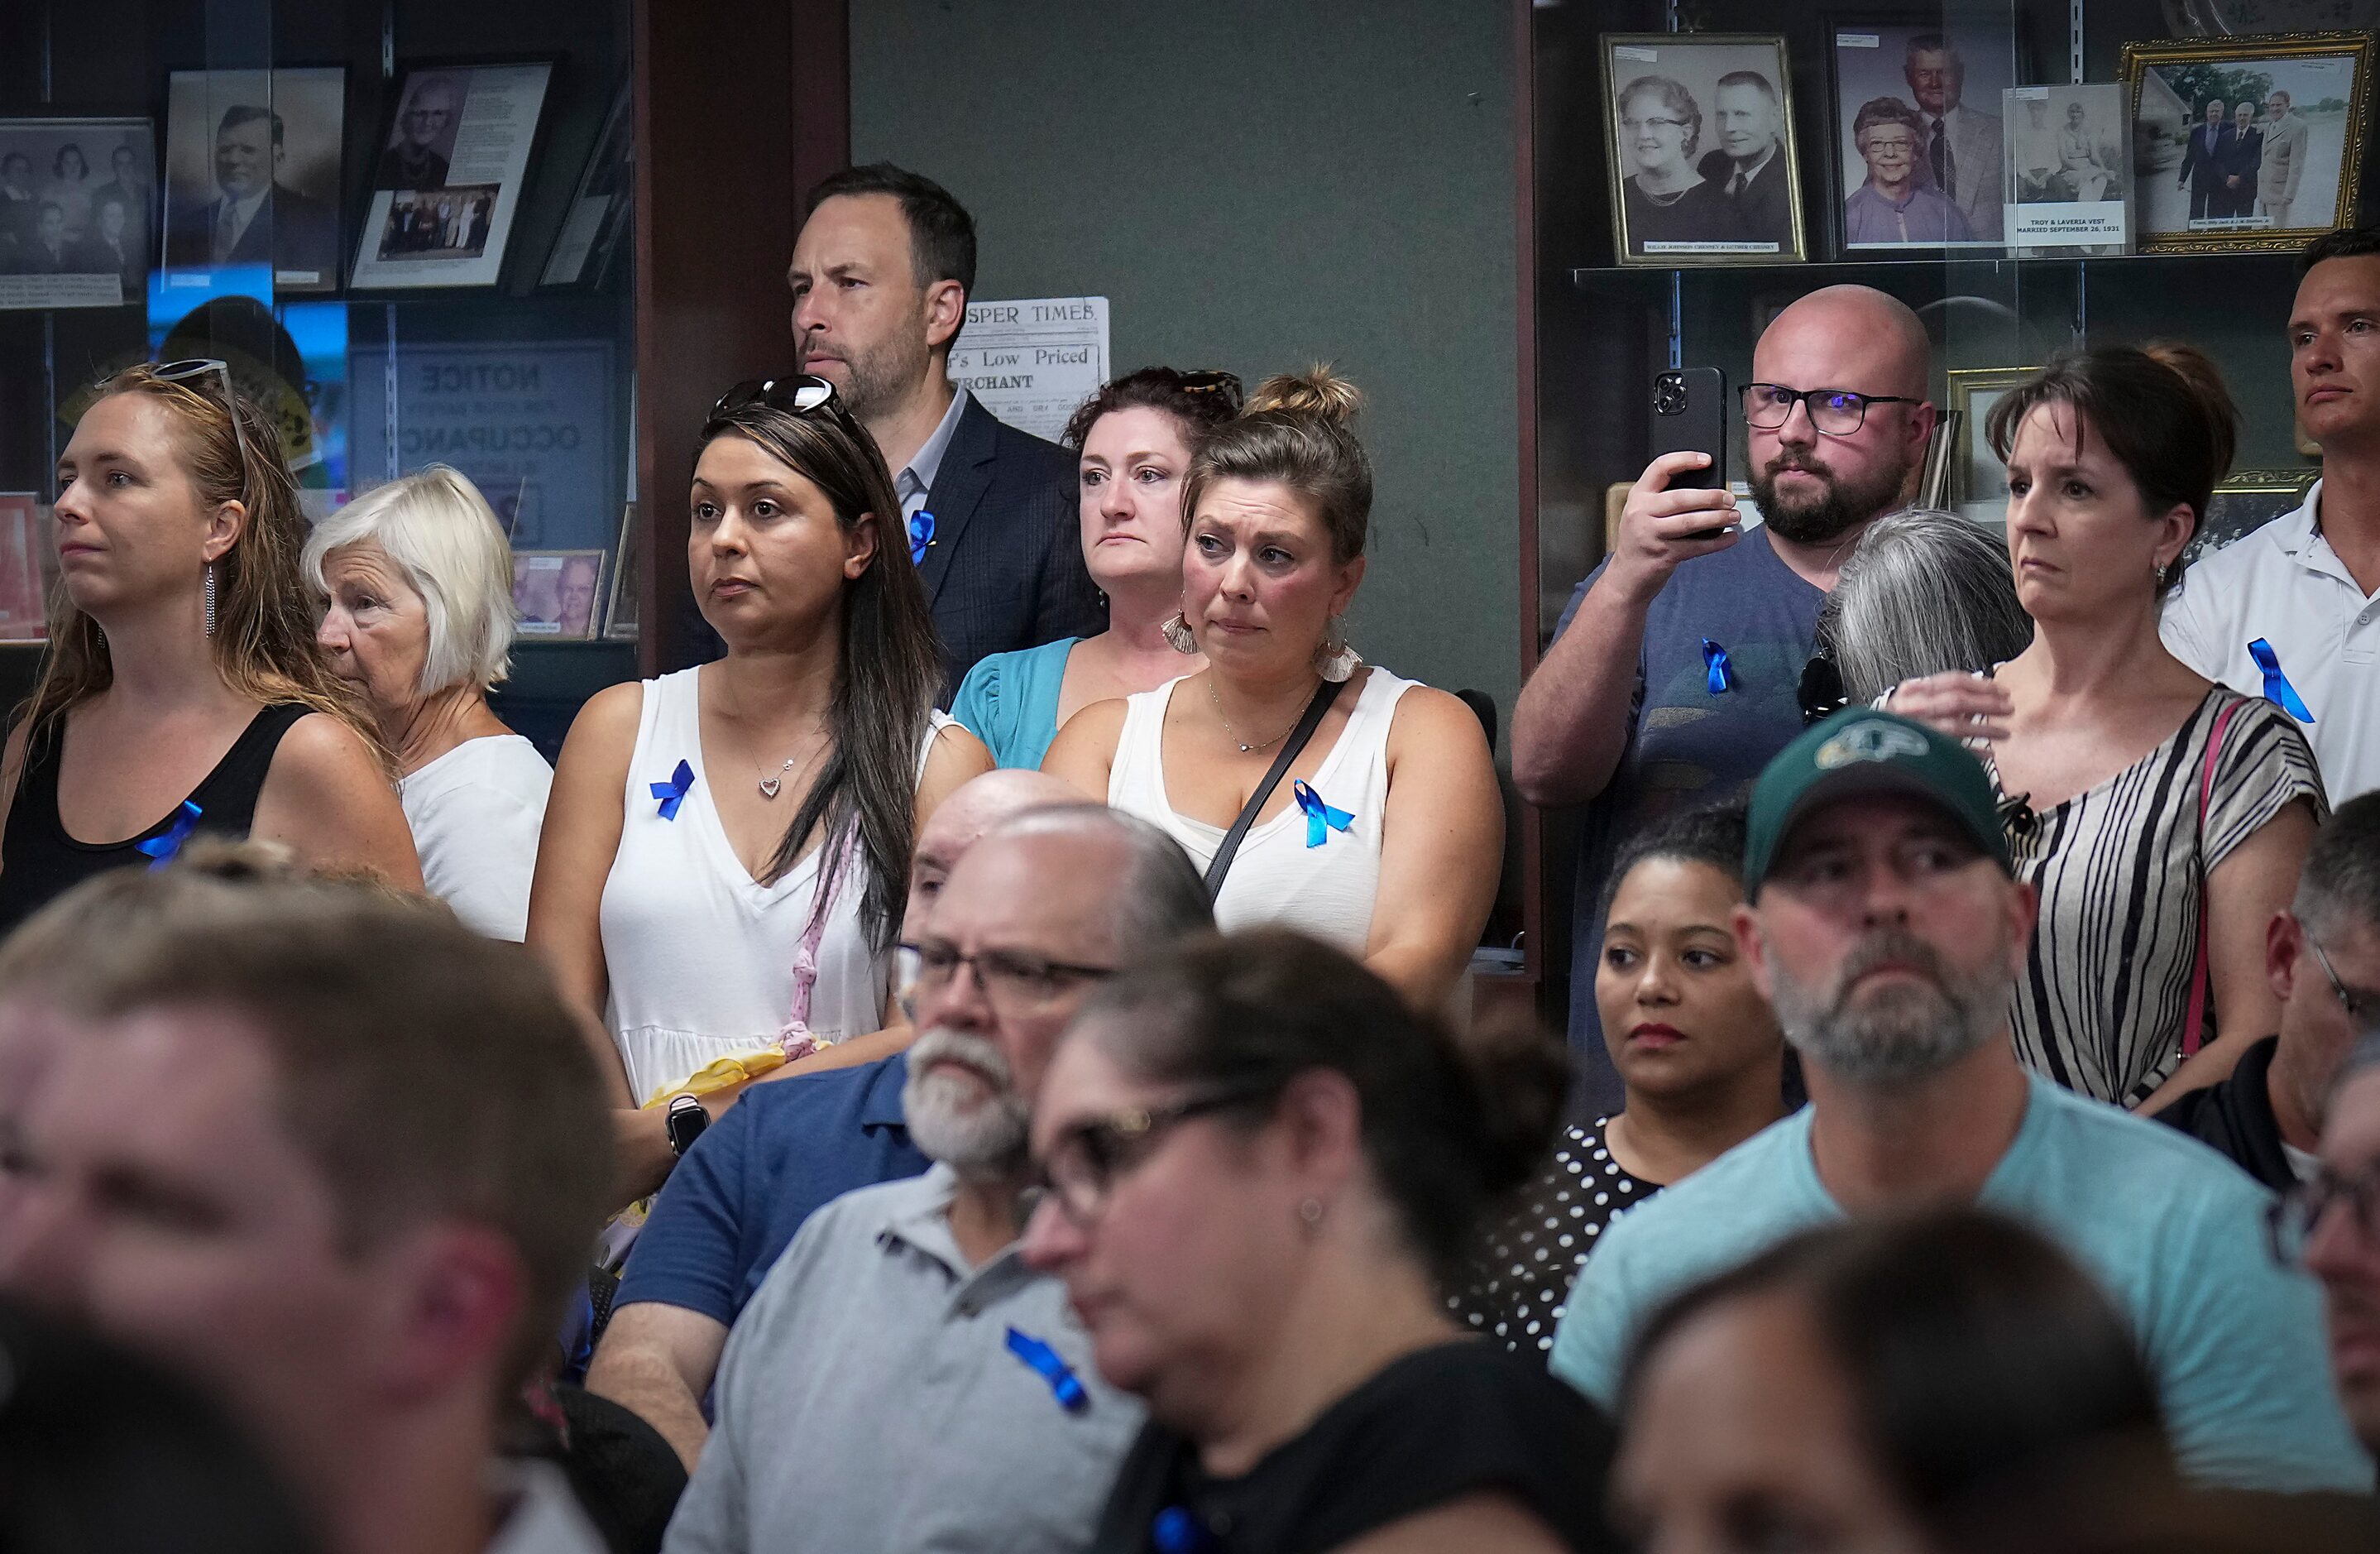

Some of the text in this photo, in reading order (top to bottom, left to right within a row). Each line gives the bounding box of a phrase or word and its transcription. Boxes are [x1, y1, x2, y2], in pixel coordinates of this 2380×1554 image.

[967, 307, 1018, 324] SPER
[983, 352, 1019, 367] Low
[1036, 348, 1088, 364] Priced
